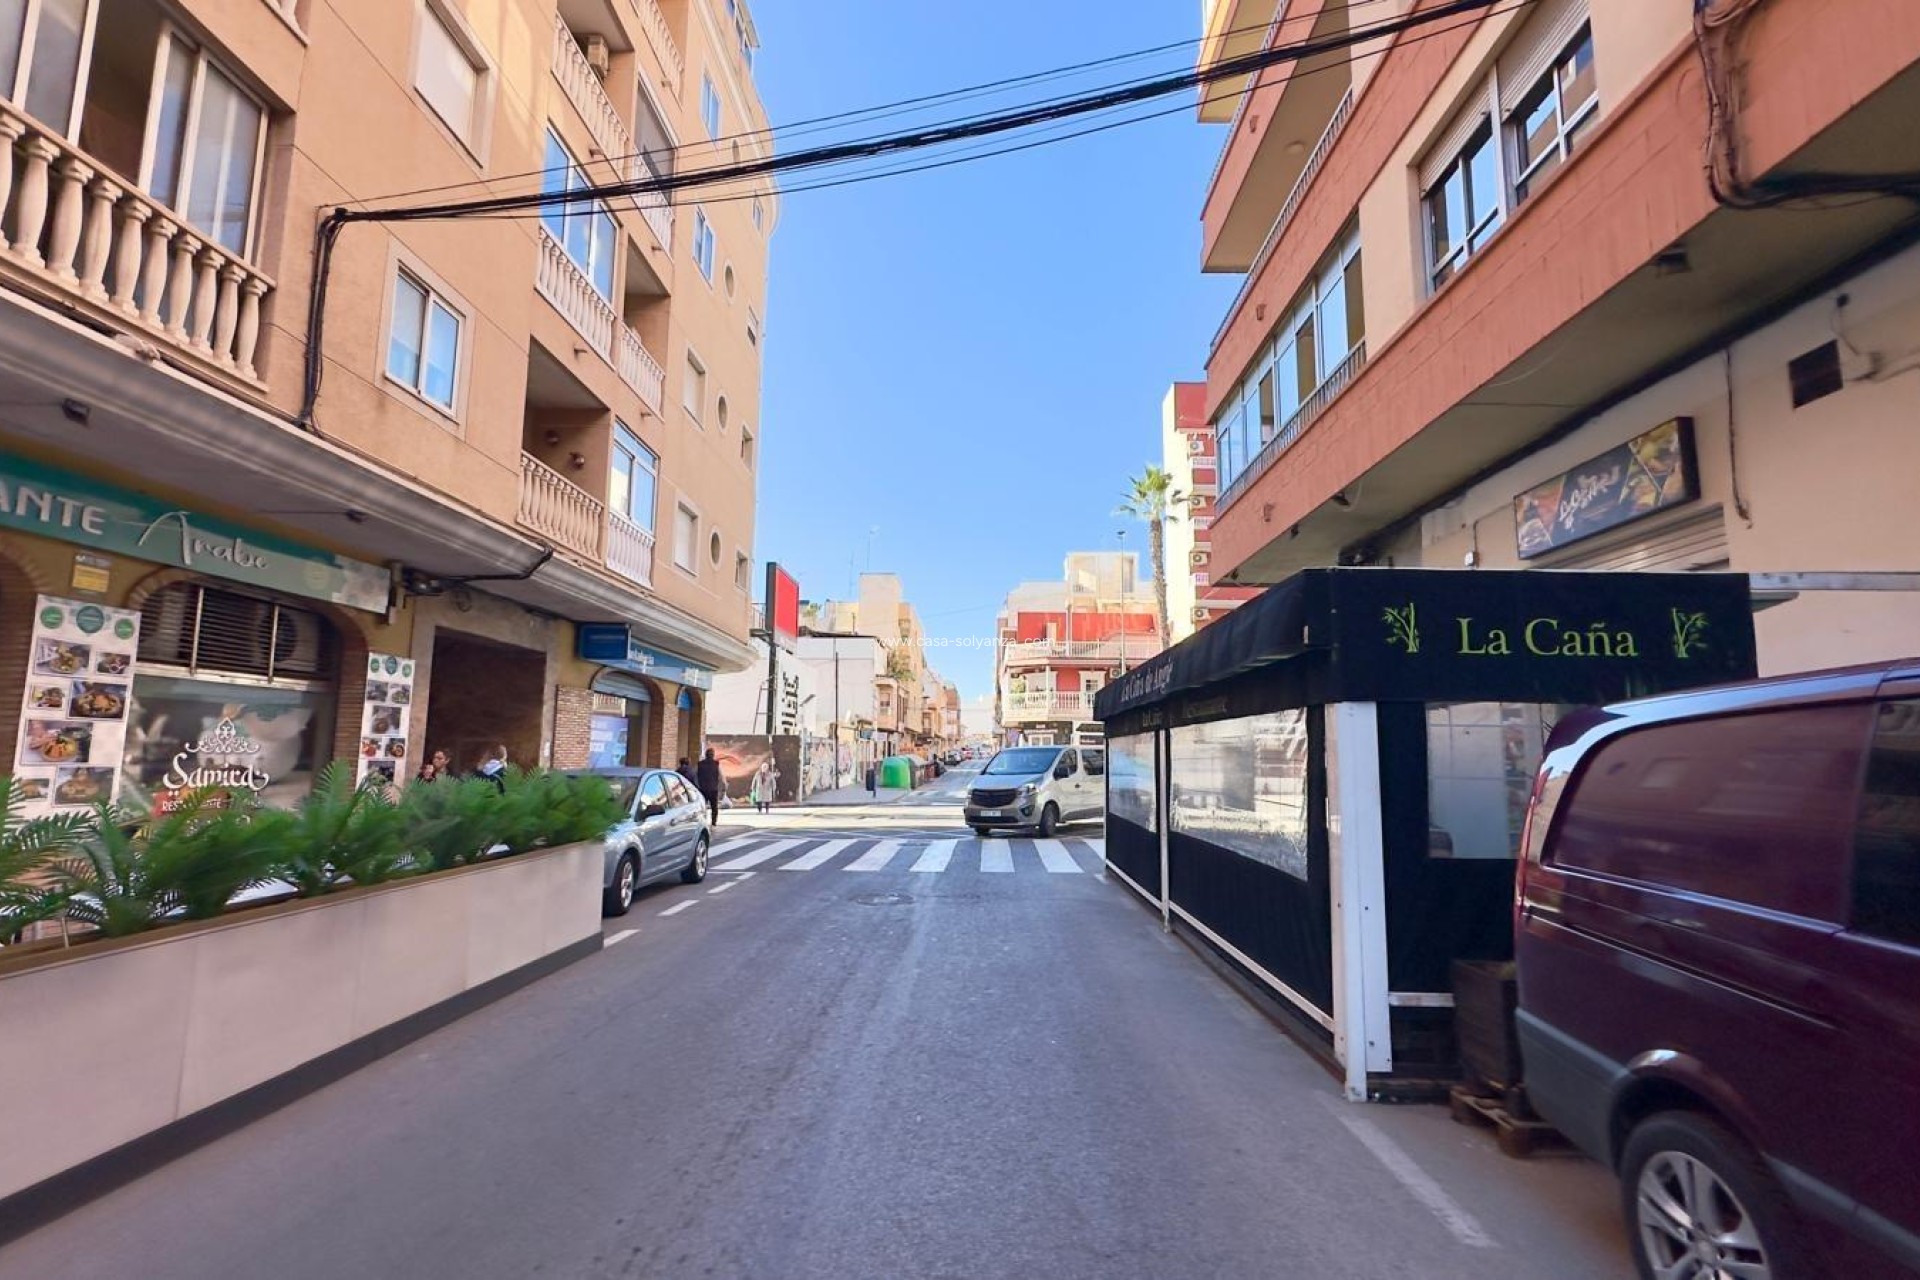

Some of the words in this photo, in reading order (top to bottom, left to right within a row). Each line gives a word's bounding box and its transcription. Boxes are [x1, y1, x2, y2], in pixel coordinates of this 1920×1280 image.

[1456, 616, 1512, 655] La
[1524, 617, 1640, 657] Caña
[162, 752, 270, 791] Samira
